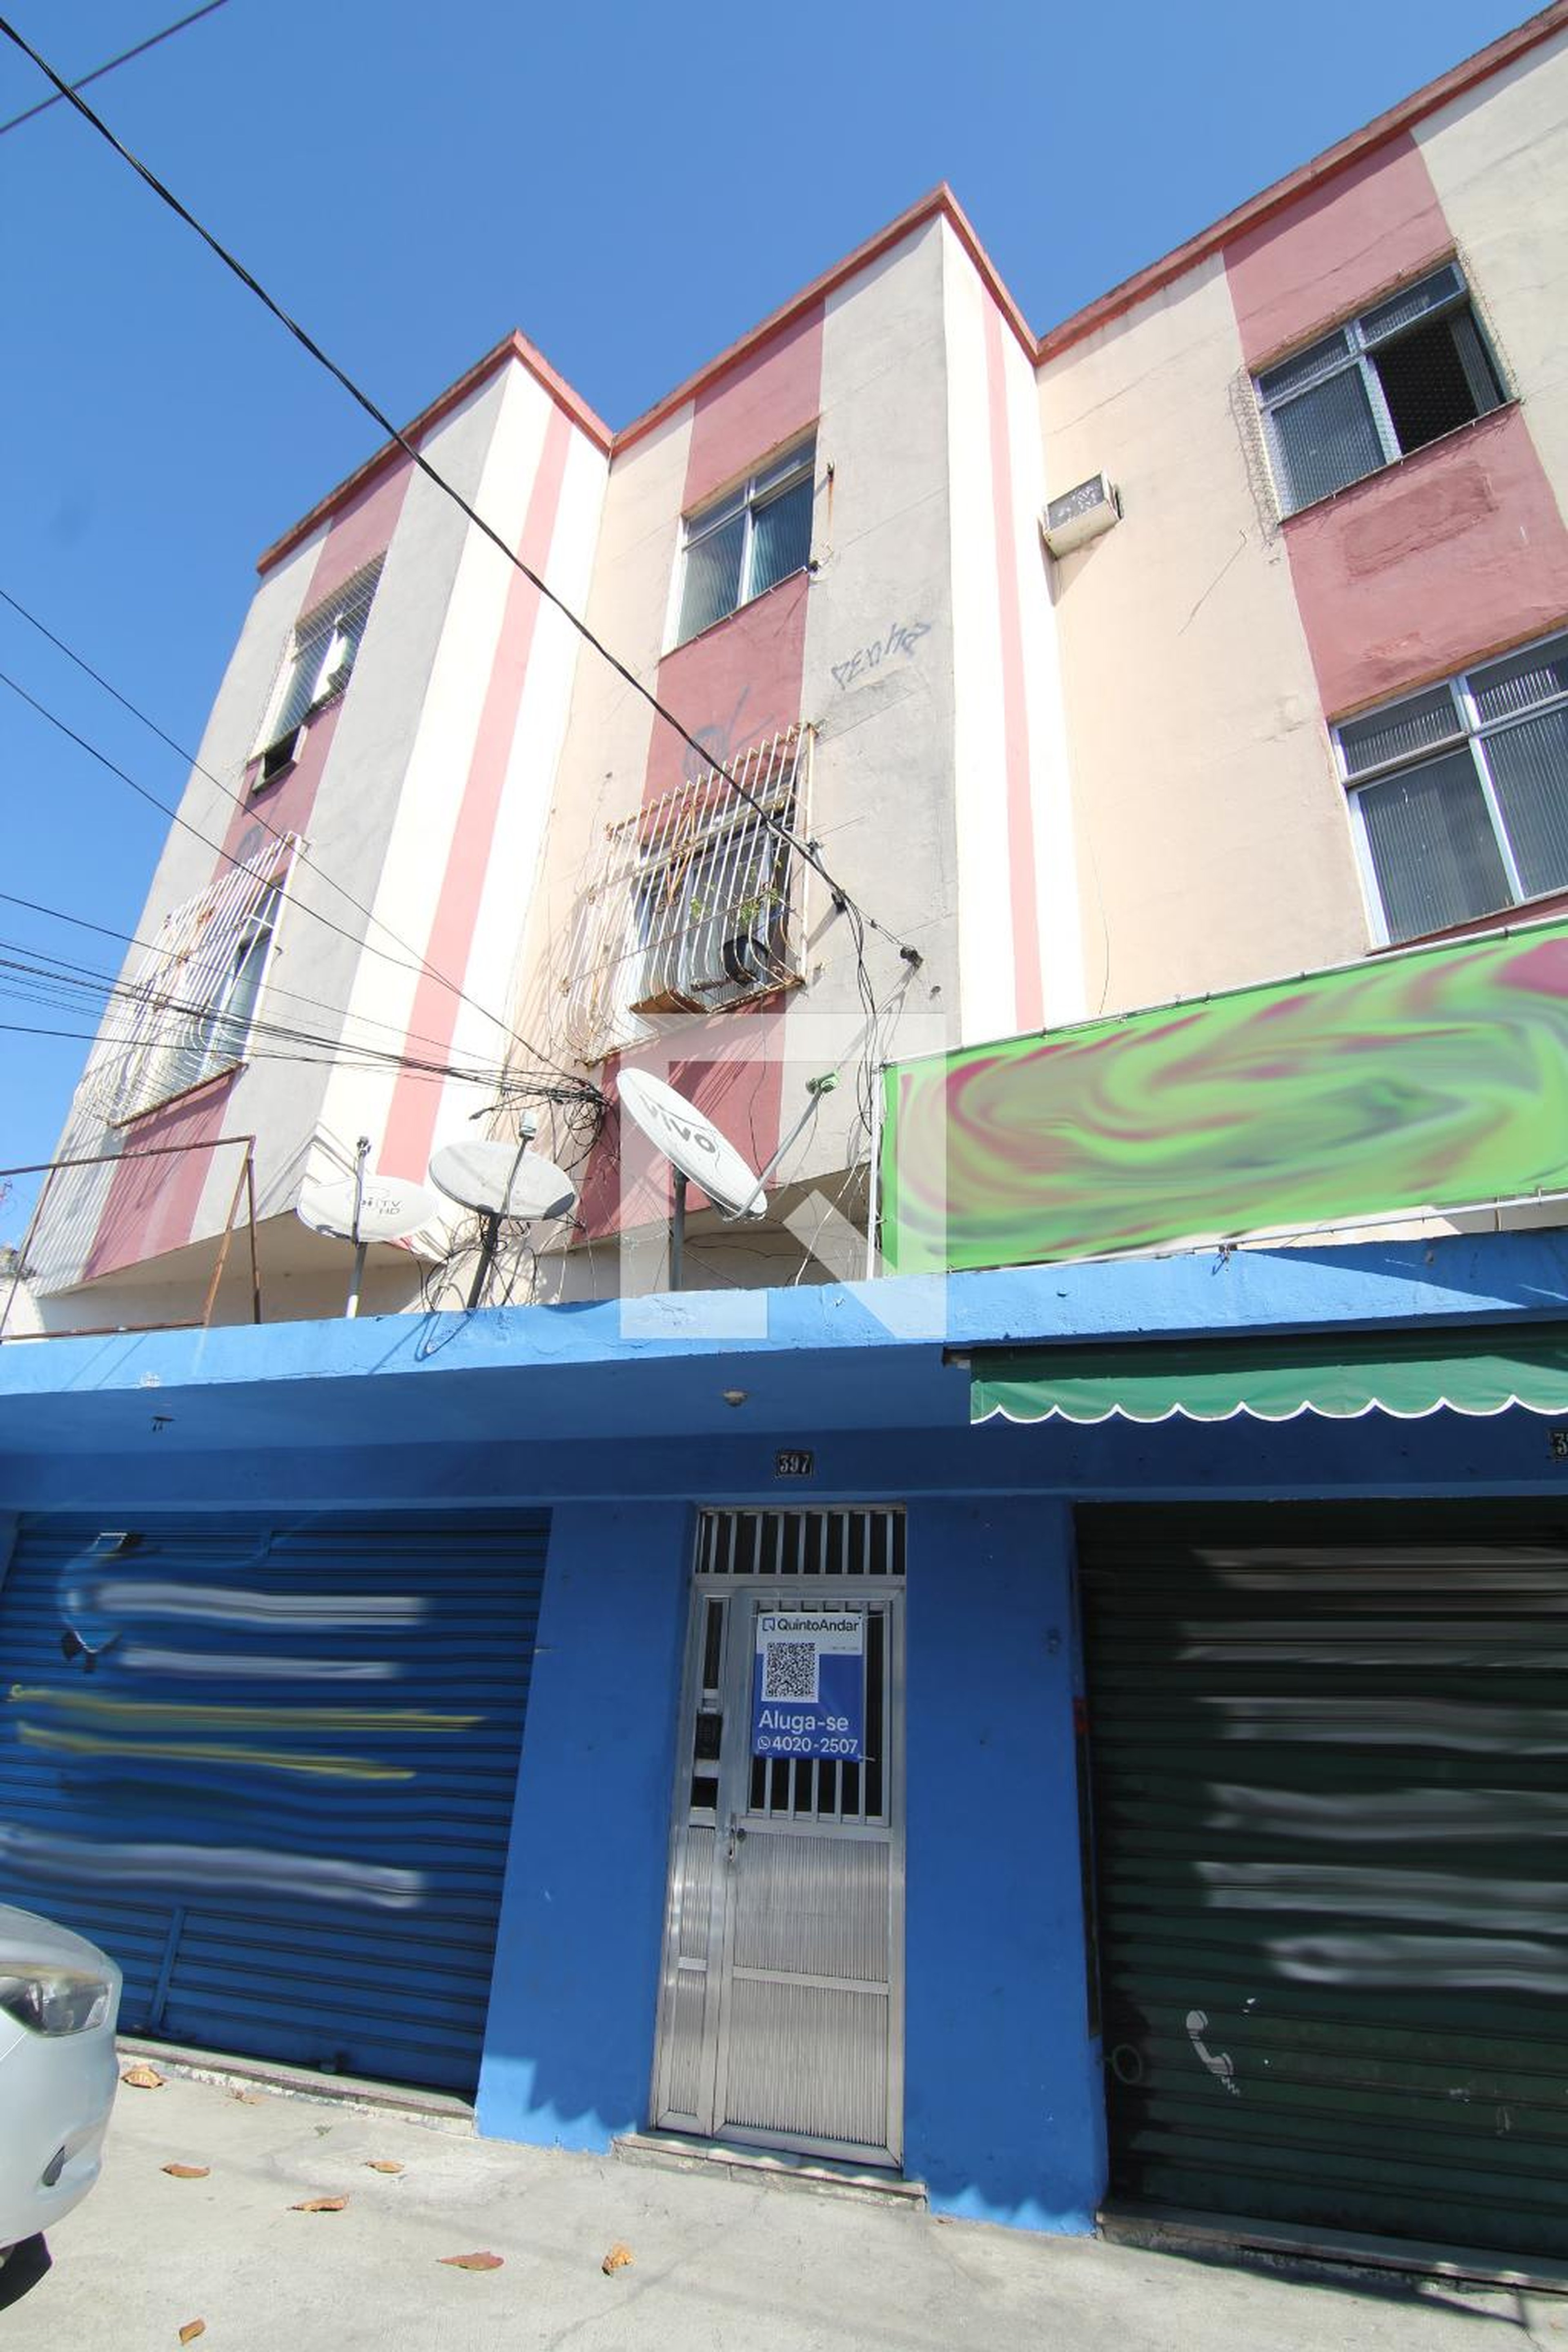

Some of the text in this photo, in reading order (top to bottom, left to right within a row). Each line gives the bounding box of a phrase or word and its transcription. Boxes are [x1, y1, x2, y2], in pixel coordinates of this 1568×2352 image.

[1554, 1432, 1568, 1455] 3
[780, 1454, 810, 1473] 397
[777, 1617, 859, 1632] QuintoAndar
[759, 1710, 849, 1735] Aluga-se
[773, 1737, 858, 1754] 4020-2507
